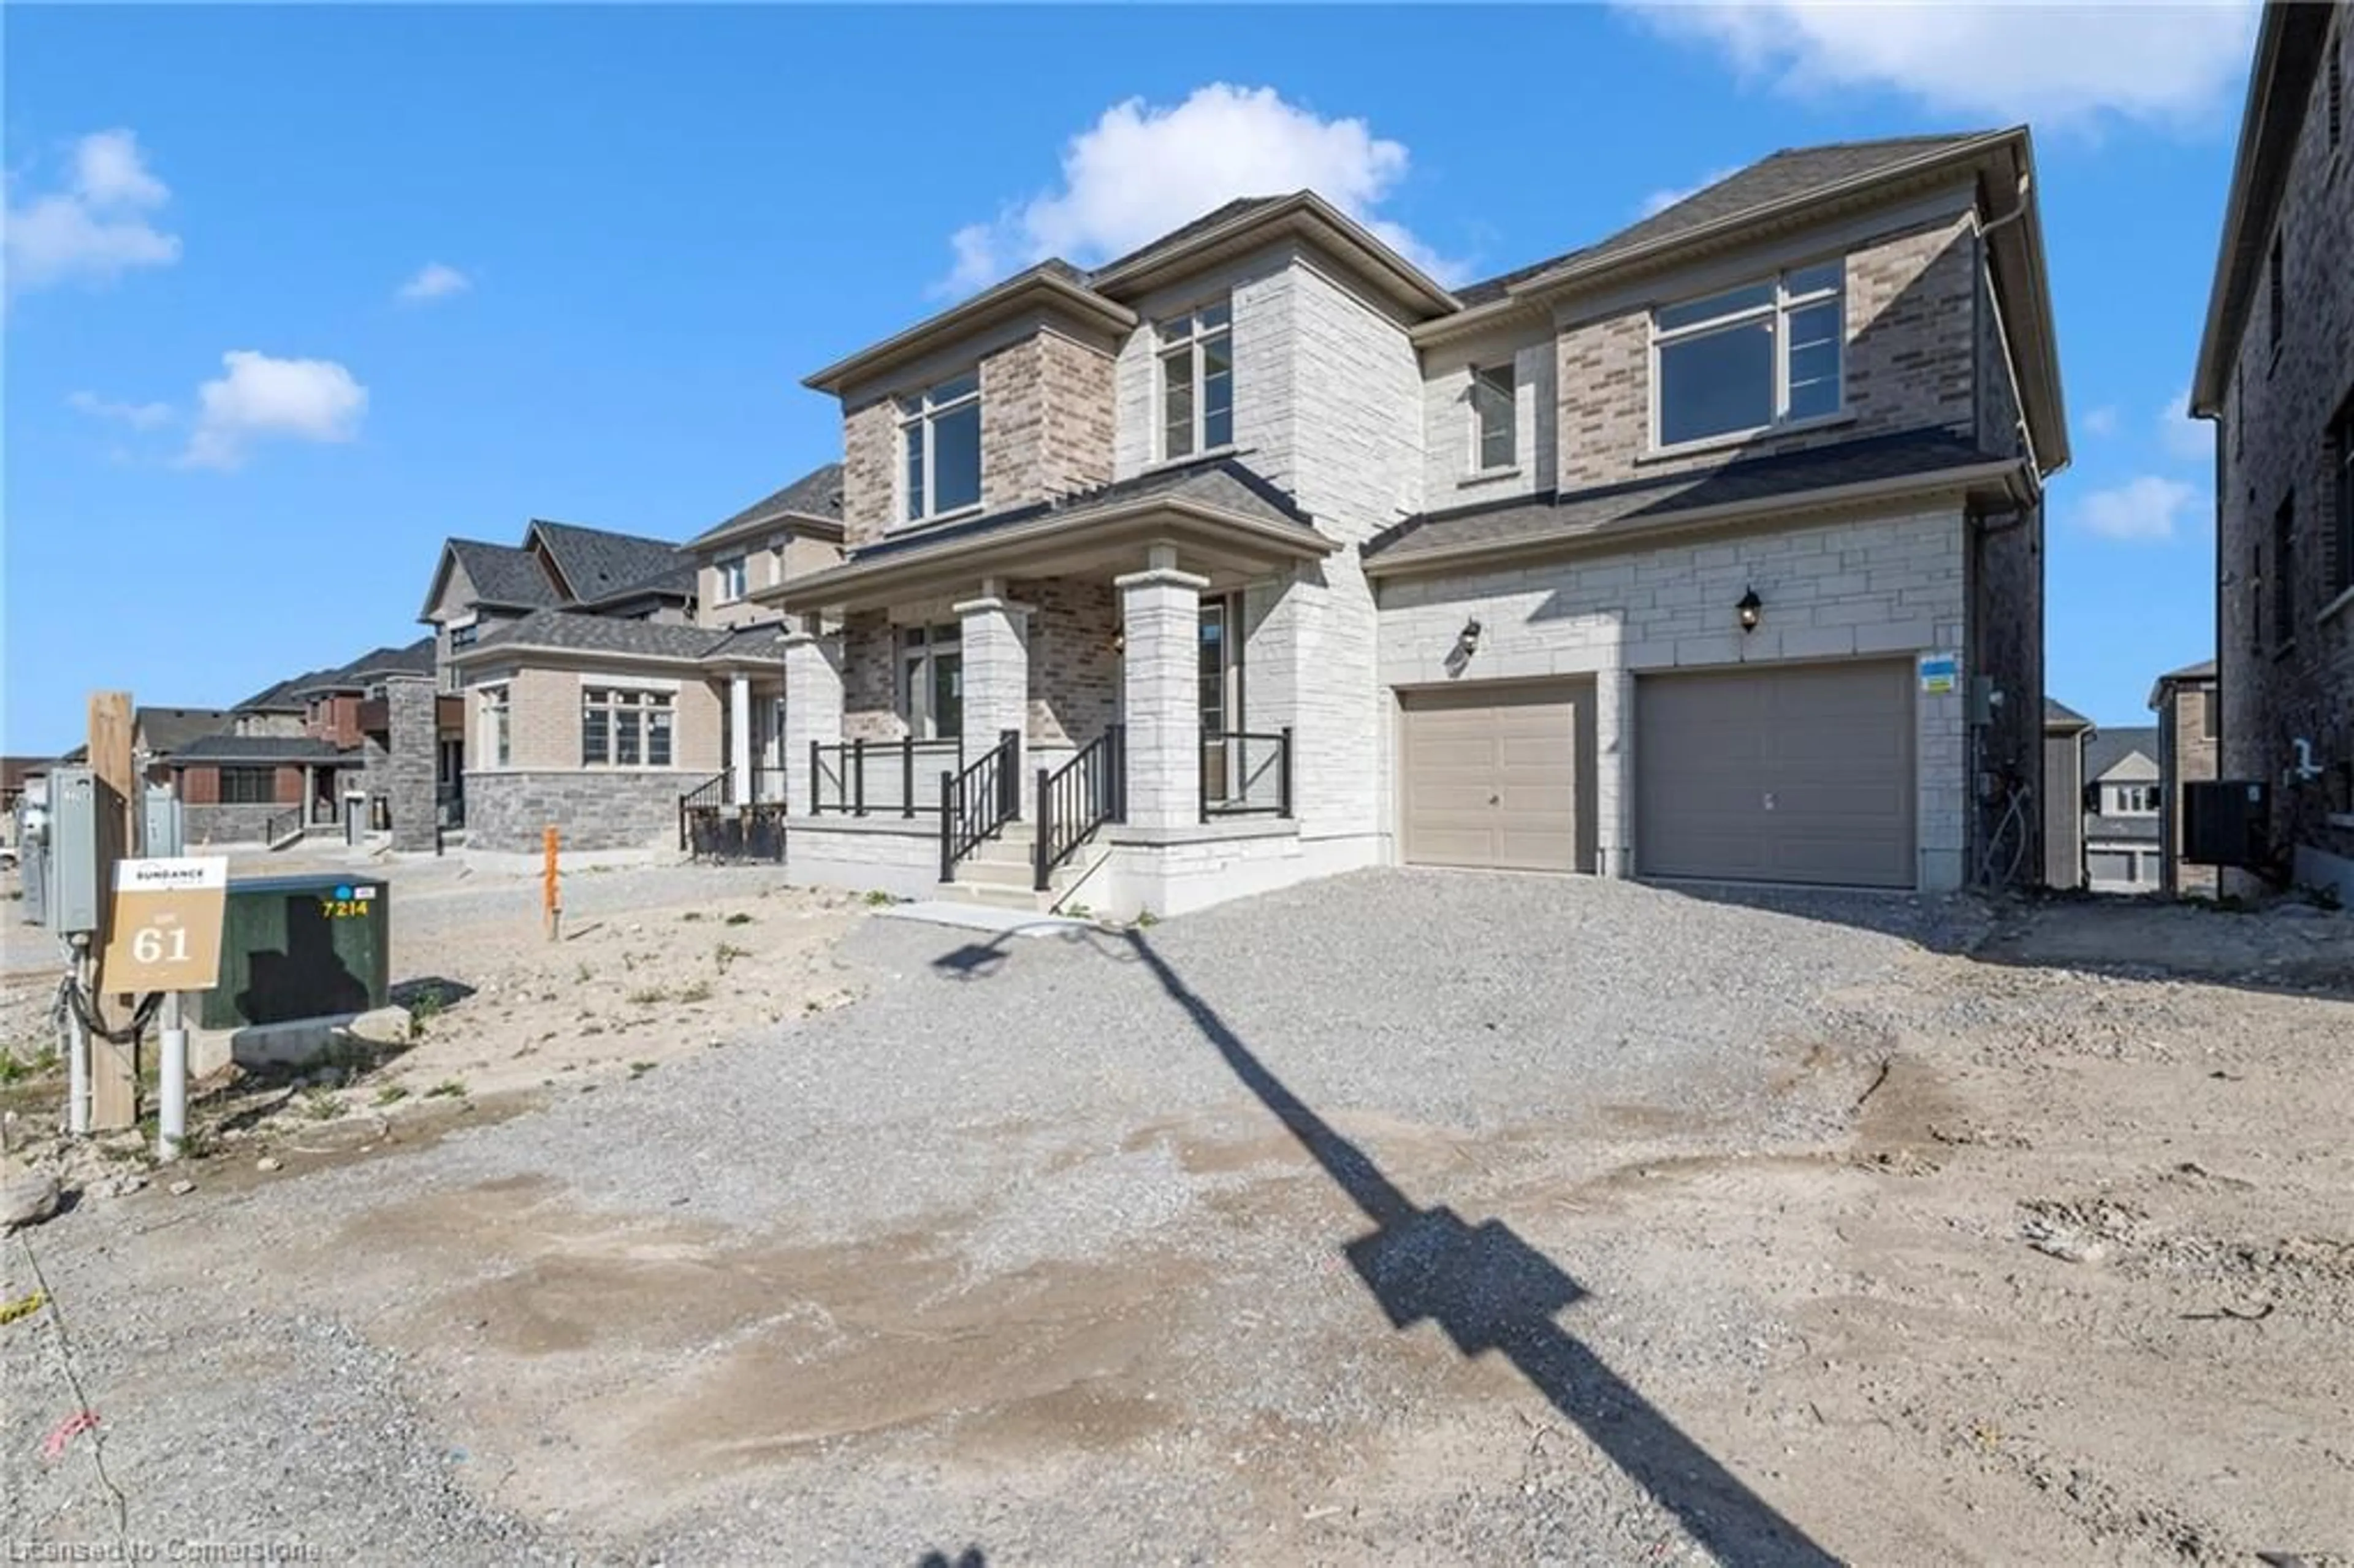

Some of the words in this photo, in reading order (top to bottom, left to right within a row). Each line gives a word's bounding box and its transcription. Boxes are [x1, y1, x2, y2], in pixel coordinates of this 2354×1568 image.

[136, 869, 203, 880] SUNDANCE
[322, 900, 368, 918] 7214
[133, 927, 192, 964] 61
